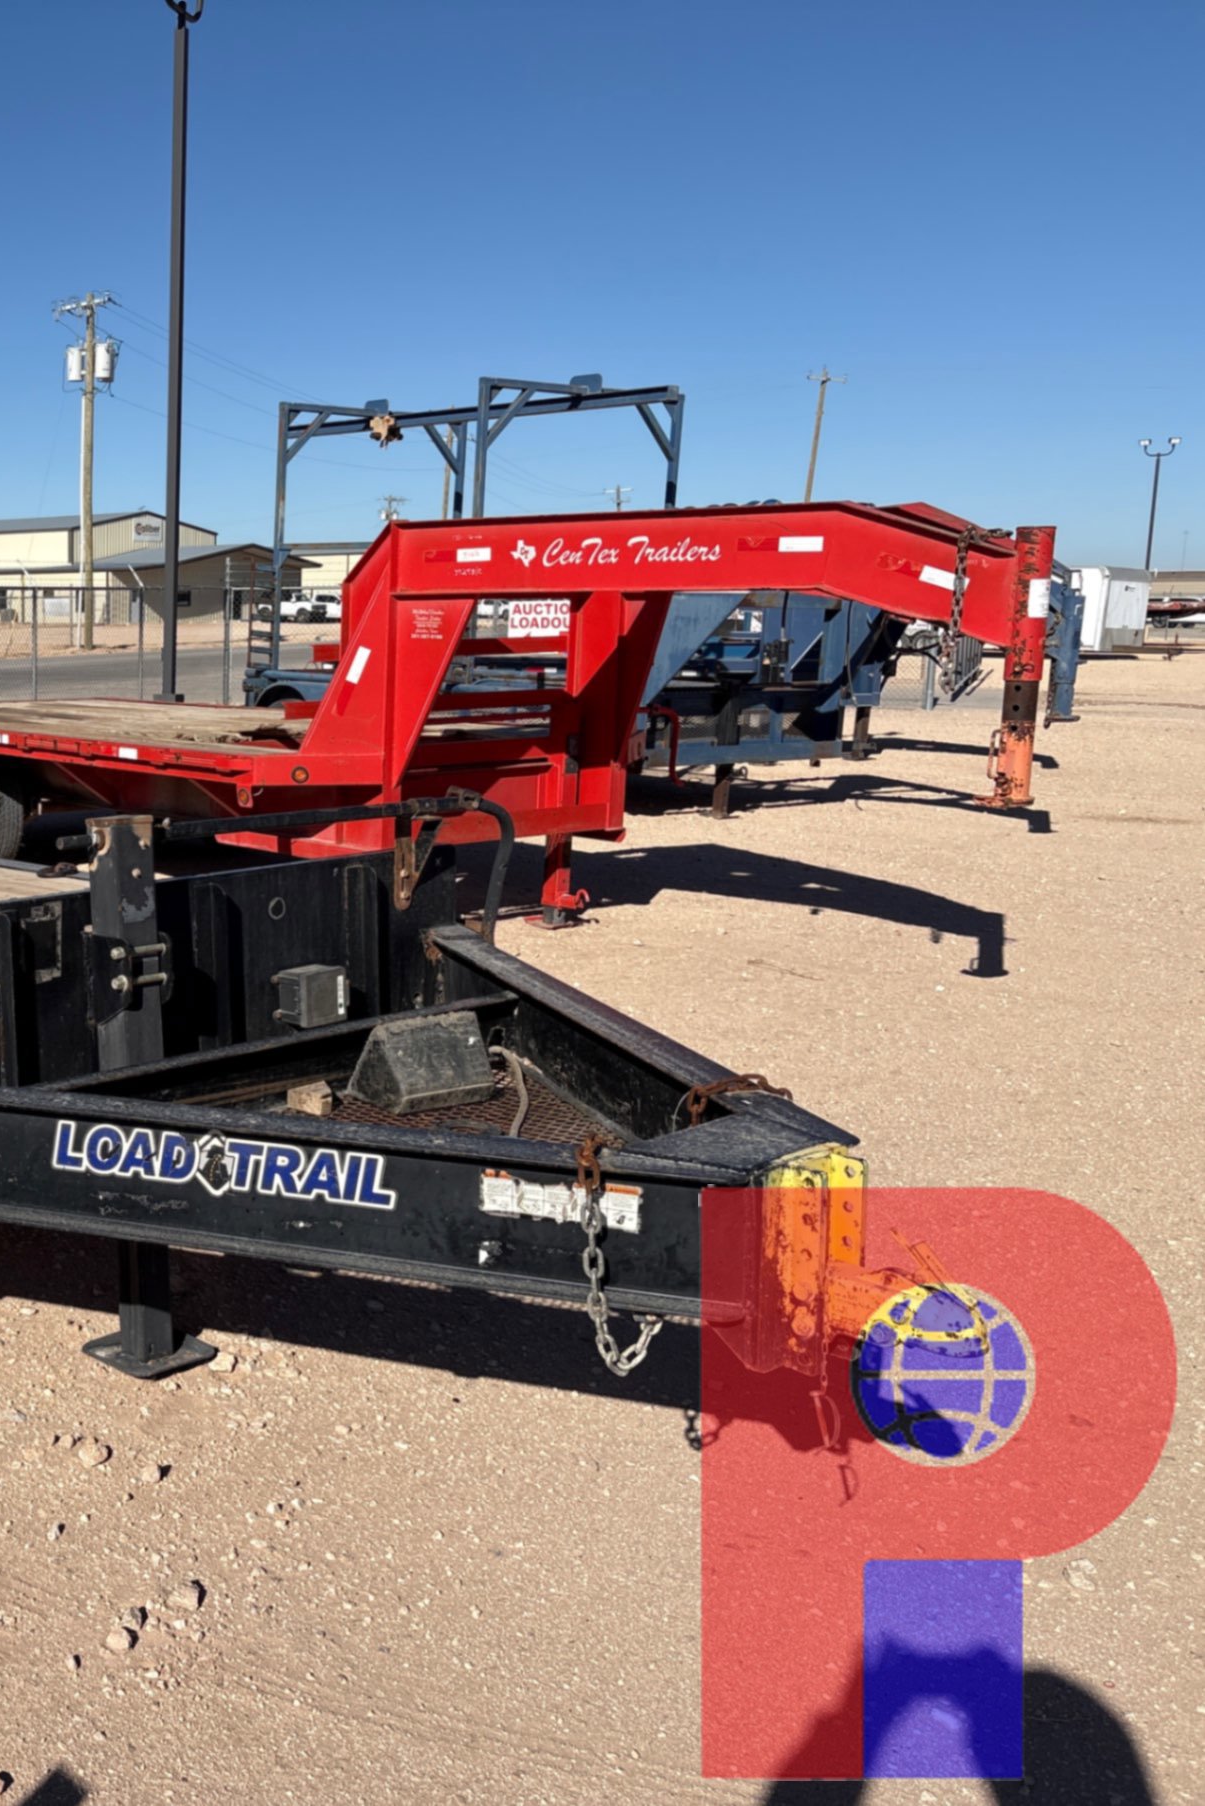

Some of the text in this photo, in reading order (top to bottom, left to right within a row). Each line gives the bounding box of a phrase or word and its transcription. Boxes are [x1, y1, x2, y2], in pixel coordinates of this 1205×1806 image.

[542, 535, 722, 568] CenTex Trailers
[512, 603, 570, 615] AUCTIO
[510, 617, 570, 629] LOADOU
[52, 1119, 397, 1210] LOAD TRAIL
